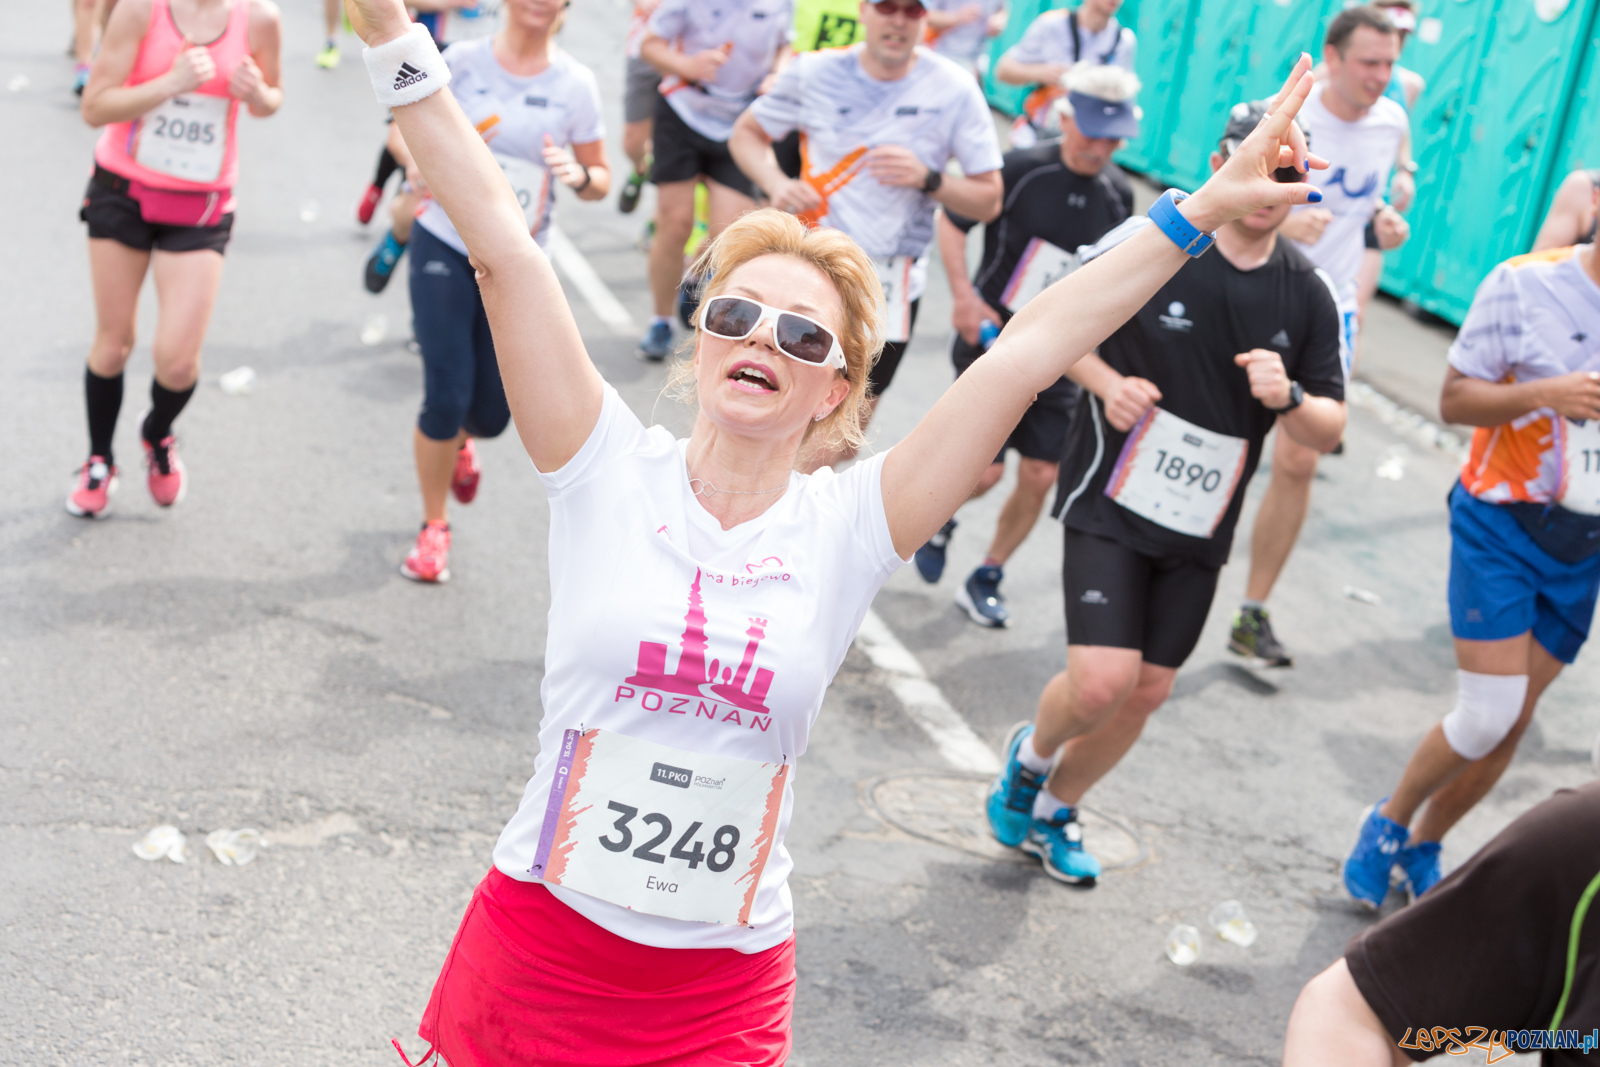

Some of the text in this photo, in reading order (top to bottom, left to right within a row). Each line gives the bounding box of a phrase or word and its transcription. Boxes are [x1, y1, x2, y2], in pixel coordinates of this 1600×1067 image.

[394, 72, 428, 90] adidas
[154, 115, 215, 145] 2085
[1154, 450, 1222, 493] 1890
[614, 685, 773, 732] POZNAŃ
[558, 766, 569, 776] D
[657, 768, 689, 783] 11. PKO
[598, 800, 741, 873] 3248
[646, 875, 679, 893] Ewa
